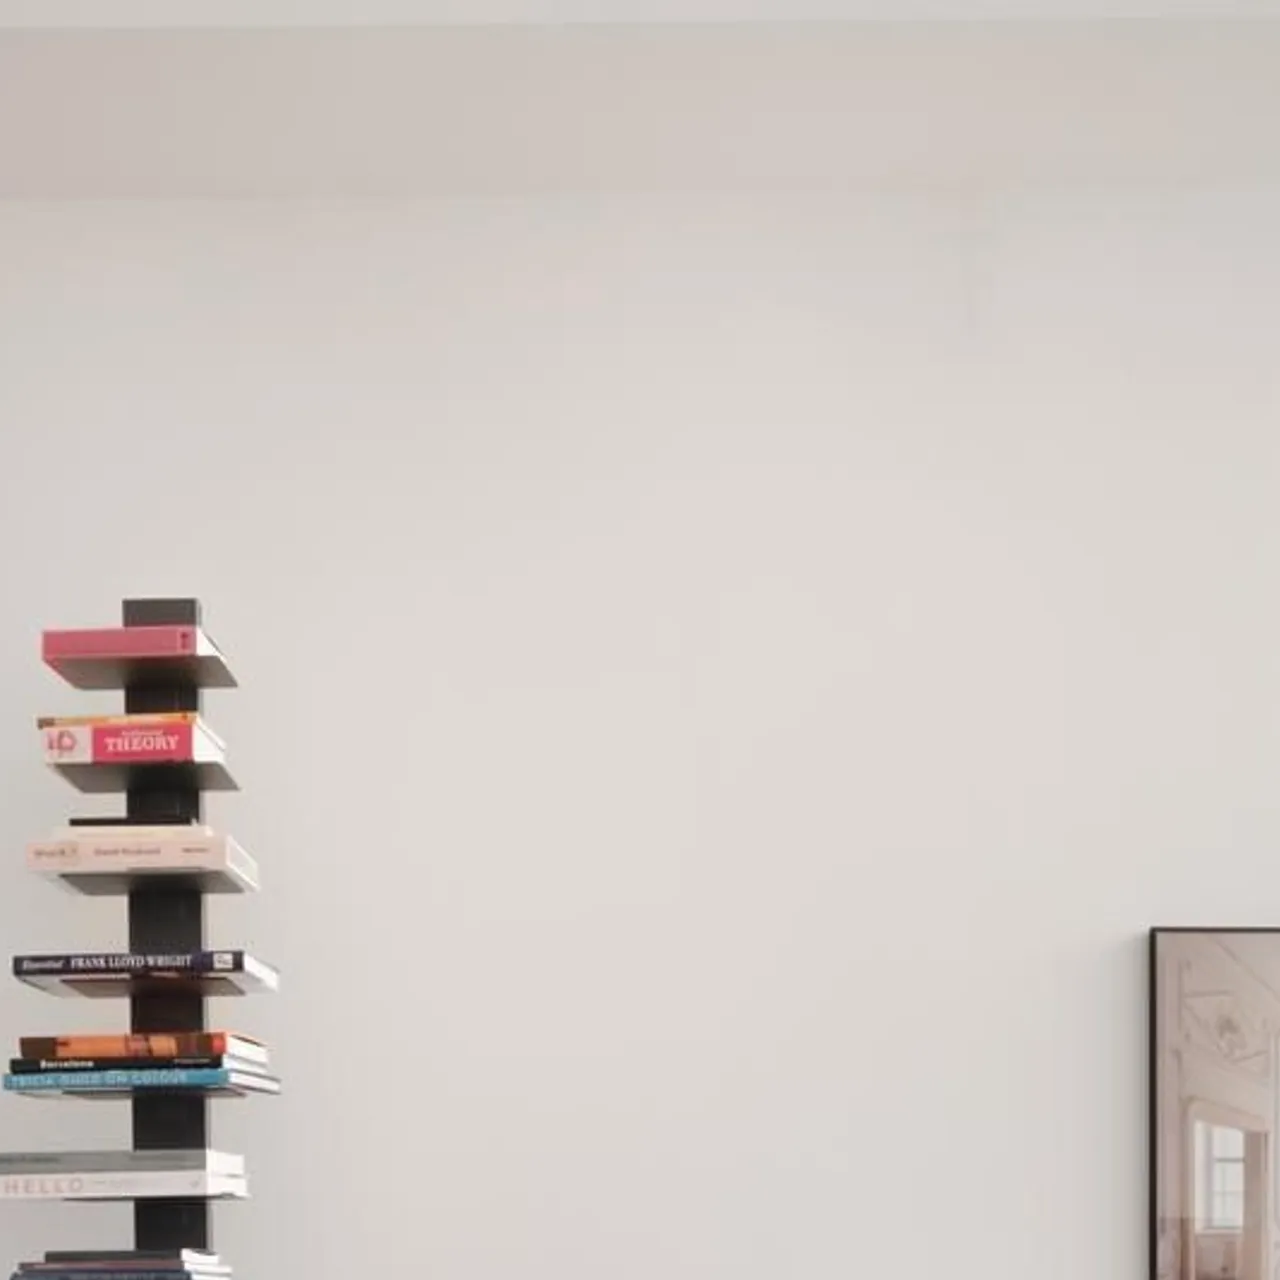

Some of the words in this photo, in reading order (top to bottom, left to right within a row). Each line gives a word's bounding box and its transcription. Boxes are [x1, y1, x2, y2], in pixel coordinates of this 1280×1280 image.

[104, 734, 180, 752] THEORY
[70, 957, 106, 969] FRANK
[108, 955, 144, 968] LLOYD
[146, 954, 193, 967] WRIGHT
